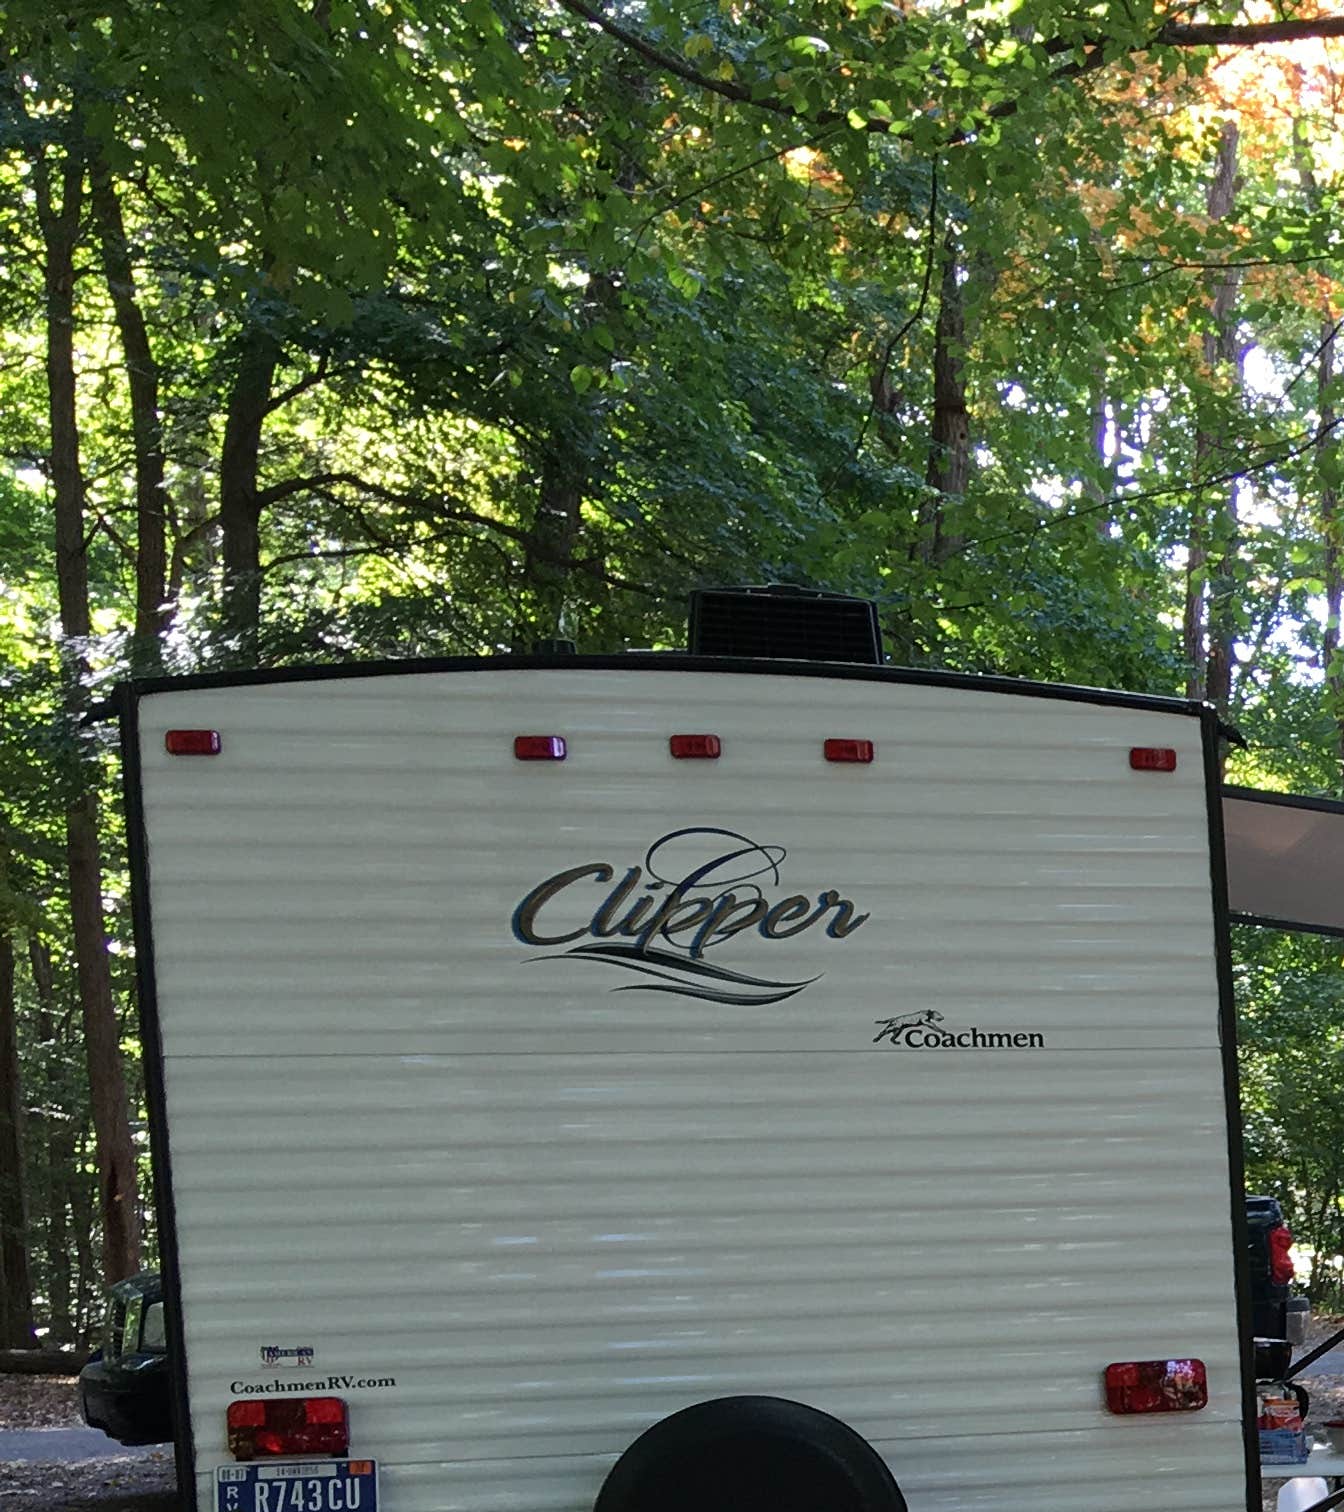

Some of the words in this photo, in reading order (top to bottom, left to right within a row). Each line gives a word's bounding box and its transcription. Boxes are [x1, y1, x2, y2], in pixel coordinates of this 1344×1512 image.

[511, 827, 870, 958] Clipper
[904, 1027, 1044, 1048] Coachmen
[230, 1375, 397, 1394] CoachmenRV.com
